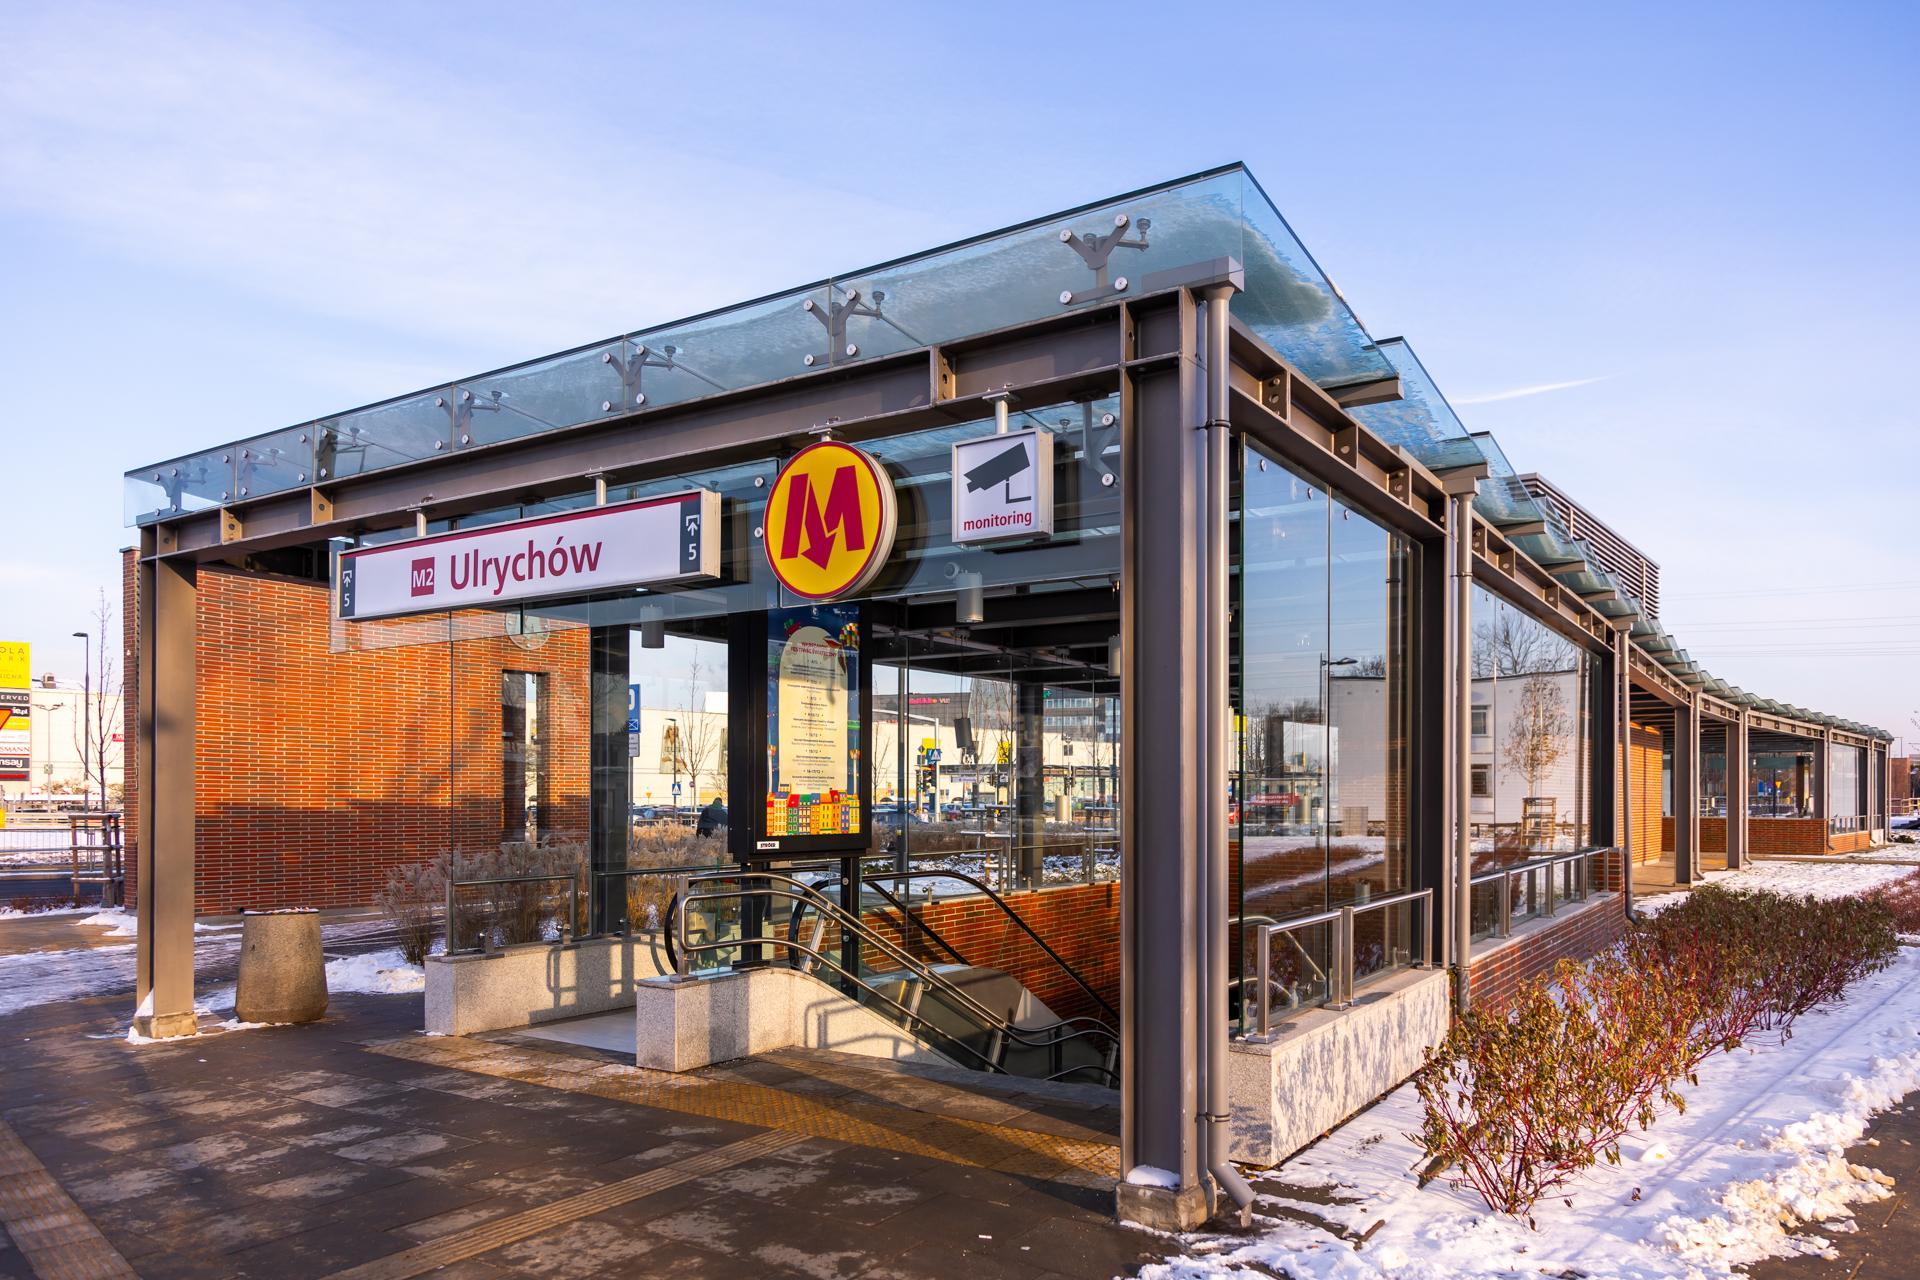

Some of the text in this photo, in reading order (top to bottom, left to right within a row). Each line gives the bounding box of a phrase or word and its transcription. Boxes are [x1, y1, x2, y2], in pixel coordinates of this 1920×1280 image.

[963, 510, 1033, 532] monitoring
[687, 543, 698, 562] 5
[412, 536, 603, 596] M2 Ulrychów
[344, 592, 351, 608] 5
